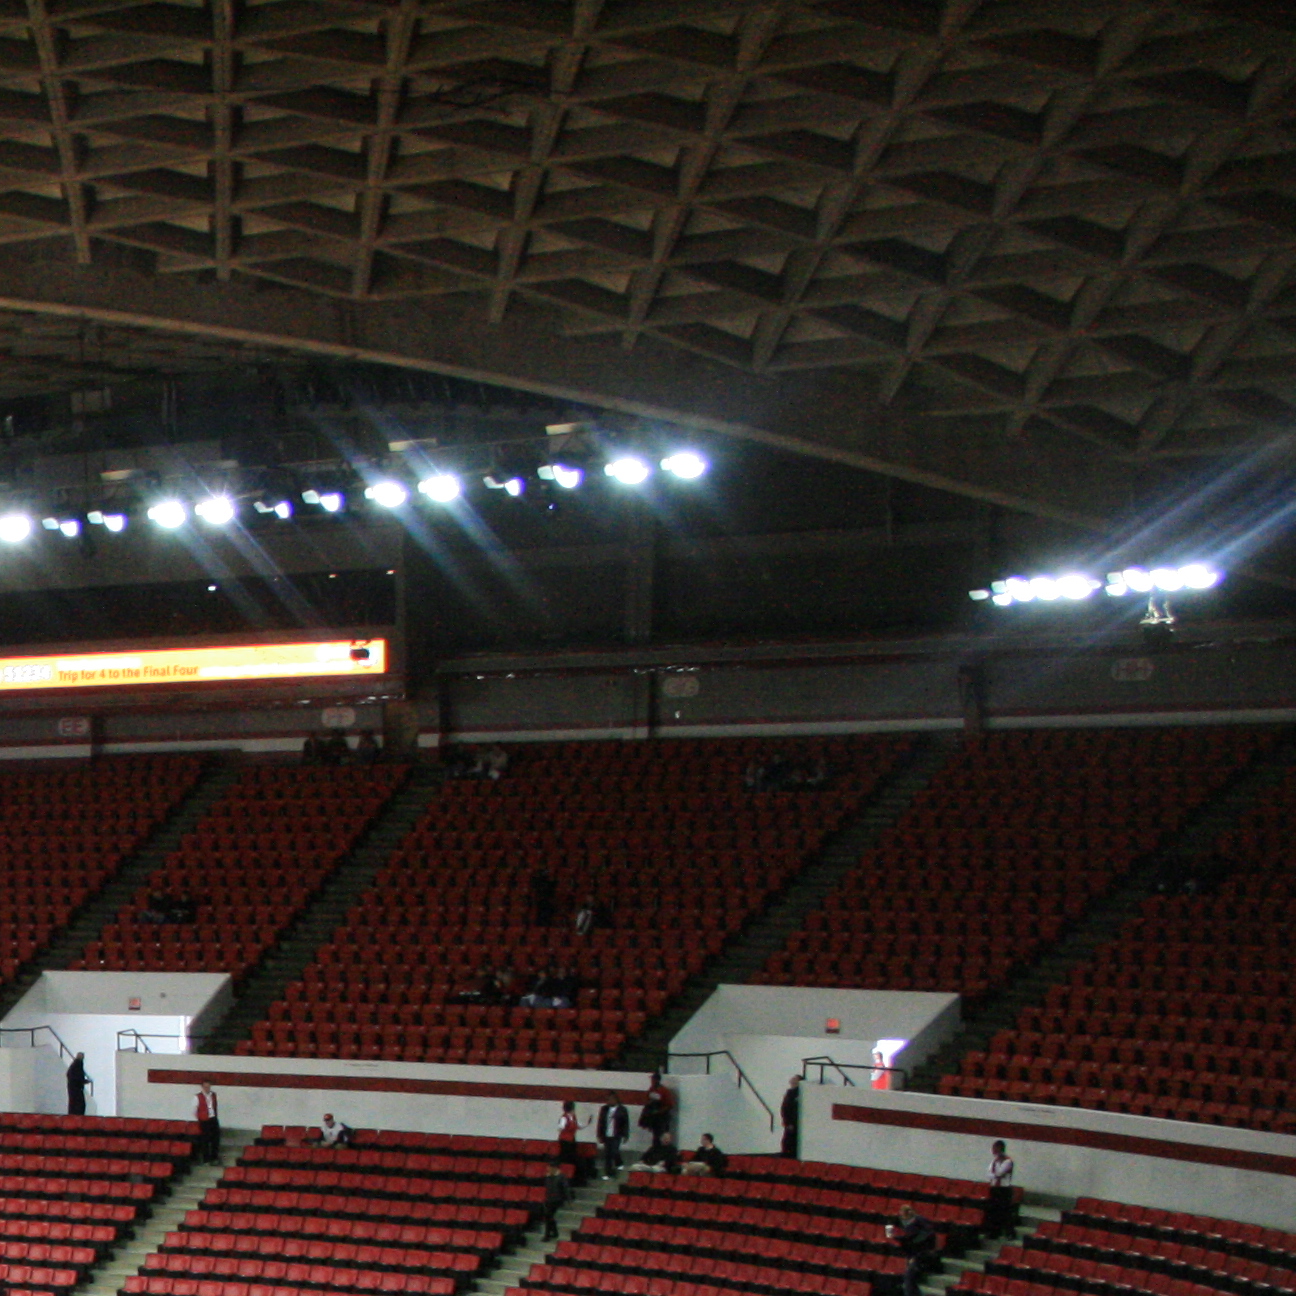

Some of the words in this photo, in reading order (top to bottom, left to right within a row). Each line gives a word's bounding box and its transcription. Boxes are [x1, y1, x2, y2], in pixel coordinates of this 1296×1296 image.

[58, 670, 79, 684] Trip
[81, 670, 97, 681] for
[99, 669, 108, 680] 4
[110, 669, 121, 680] to
[122, 667, 141, 679] the
[143, 665, 171, 678] Final
[173, 664, 199, 677] Four
